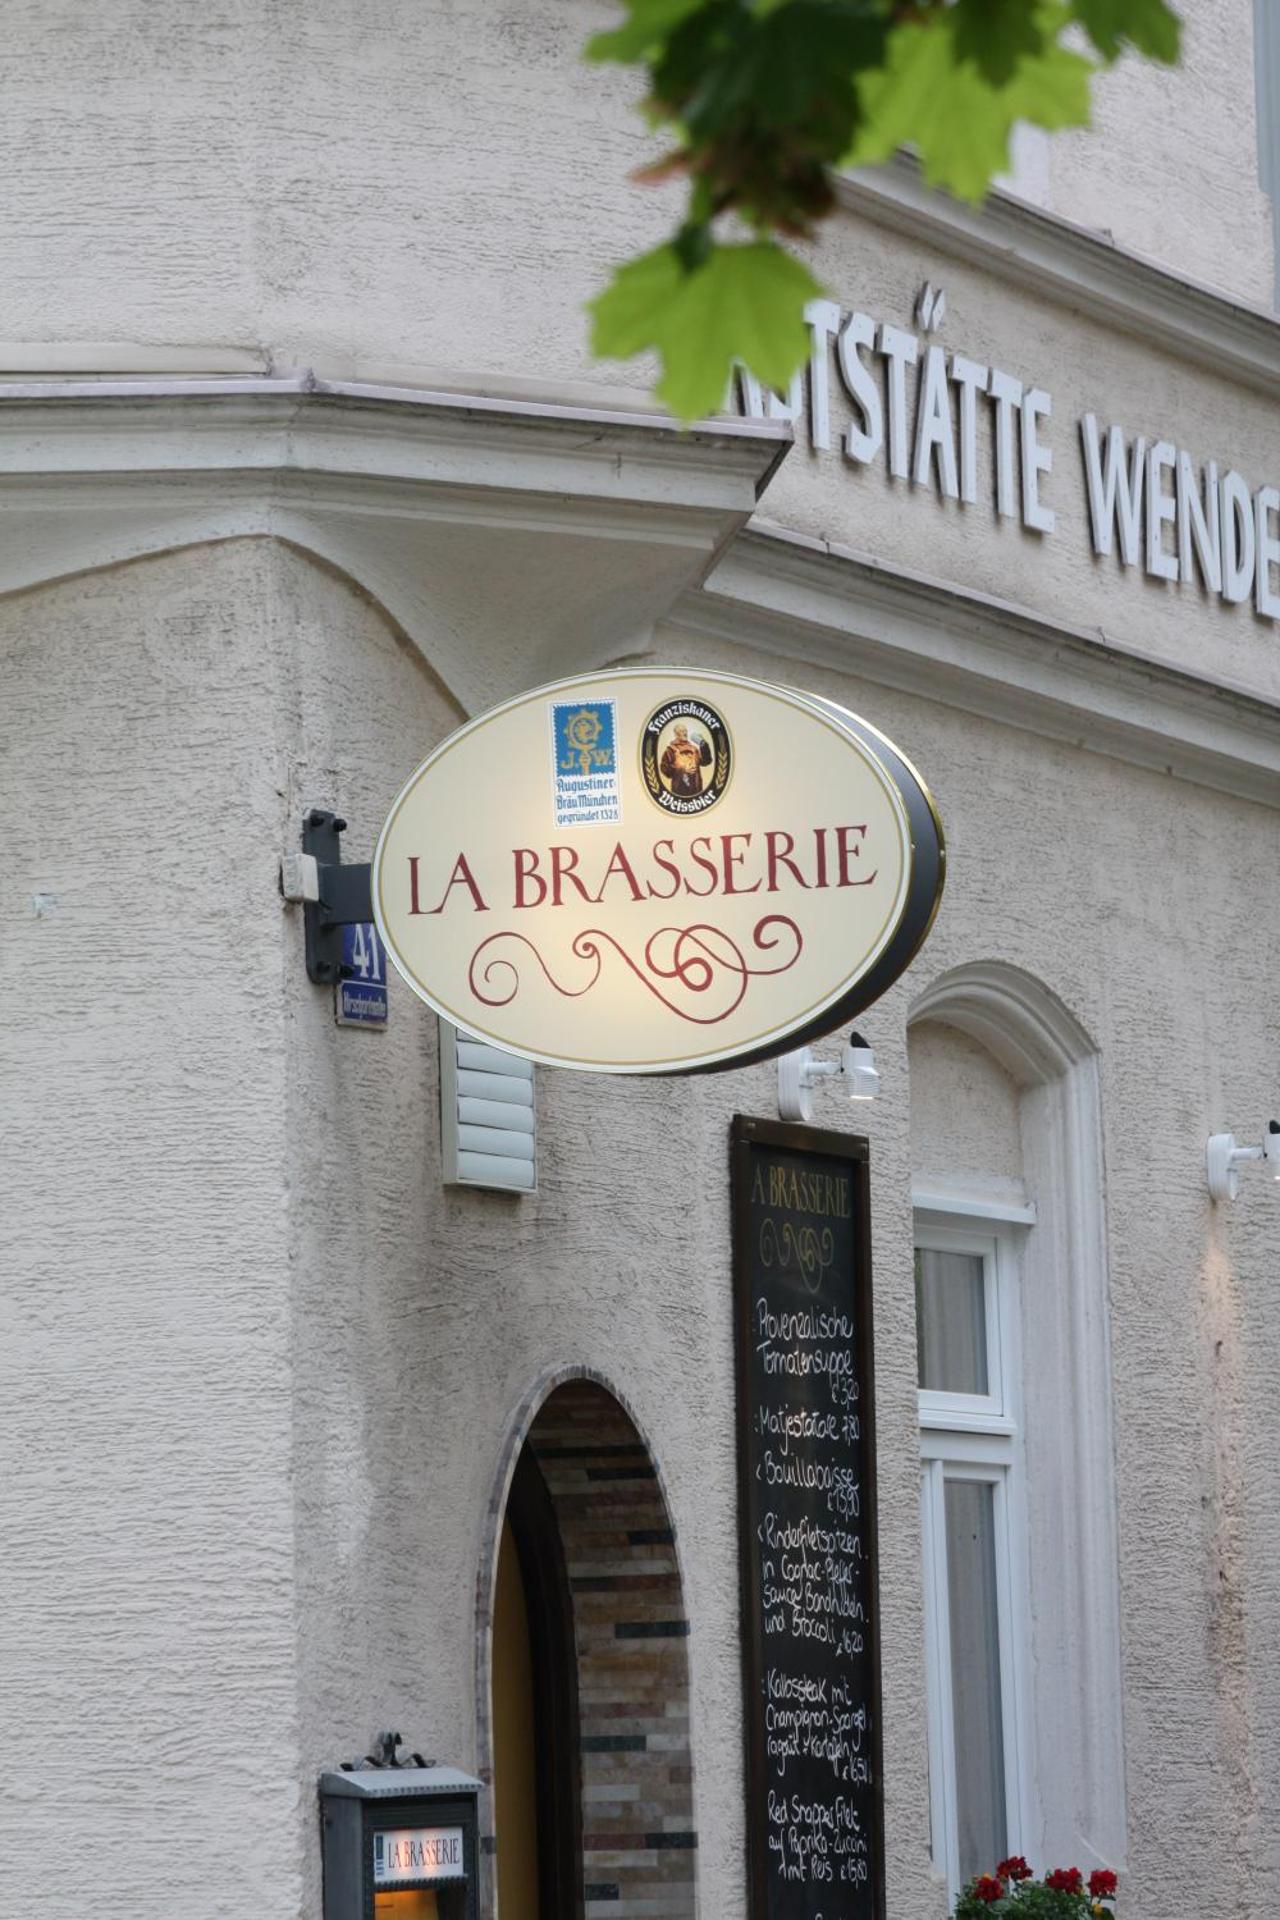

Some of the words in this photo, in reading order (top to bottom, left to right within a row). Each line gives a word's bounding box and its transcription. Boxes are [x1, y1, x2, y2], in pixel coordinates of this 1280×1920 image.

[648, 701, 721, 736] Franziskaner
[658, 789, 717, 813] Weissbier
[407, 852, 490, 915] LA
[512, 824, 879, 910] BRASSERIE
[352, 922, 381, 980] 41
[769, 1165, 852, 1218] BRASSERIE
[756, 1297, 854, 1341] Provenzalische
[756, 1340, 854, 1386] Tomatensuppe
[764, 1608, 786, 1634] und
[767, 1789, 788, 1824] Red
[388, 1842, 402, 1869] LA
[404, 1837, 461, 1868] BRASSERIE
[811, 1854, 833, 1882] Reis
